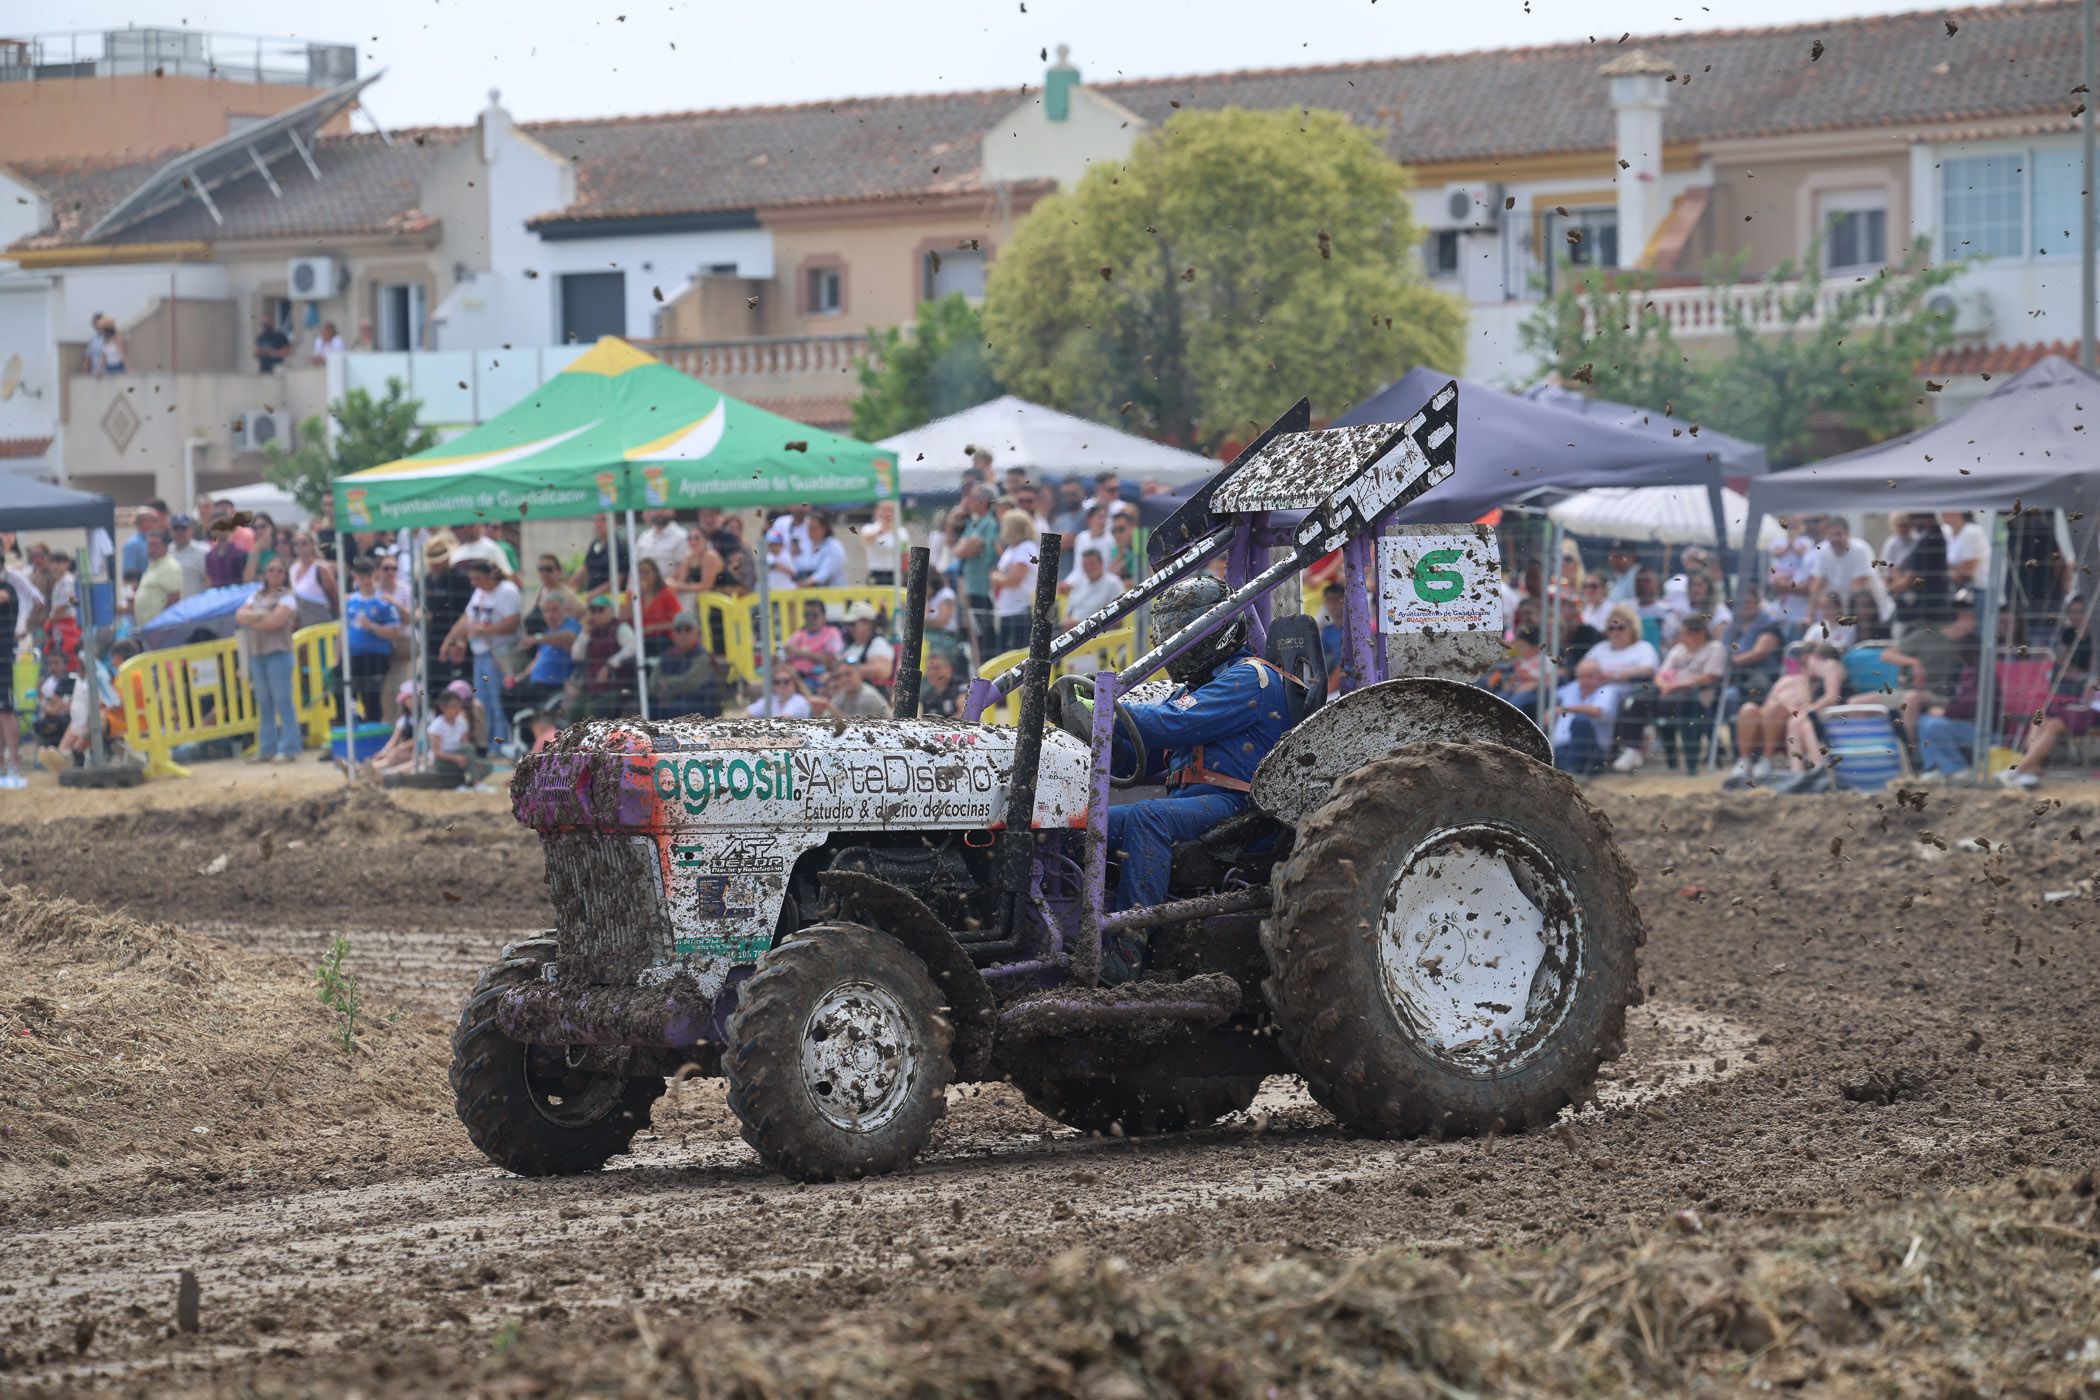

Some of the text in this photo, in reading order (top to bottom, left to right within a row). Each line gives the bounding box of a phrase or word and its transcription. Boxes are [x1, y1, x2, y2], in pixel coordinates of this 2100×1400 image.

[1413, 550, 1464, 603] 6
[805, 796, 854, 820] Estudio
[859, 800, 869, 818] &
[923, 795, 939, 818] de
[944, 798, 990, 818] cocinas
